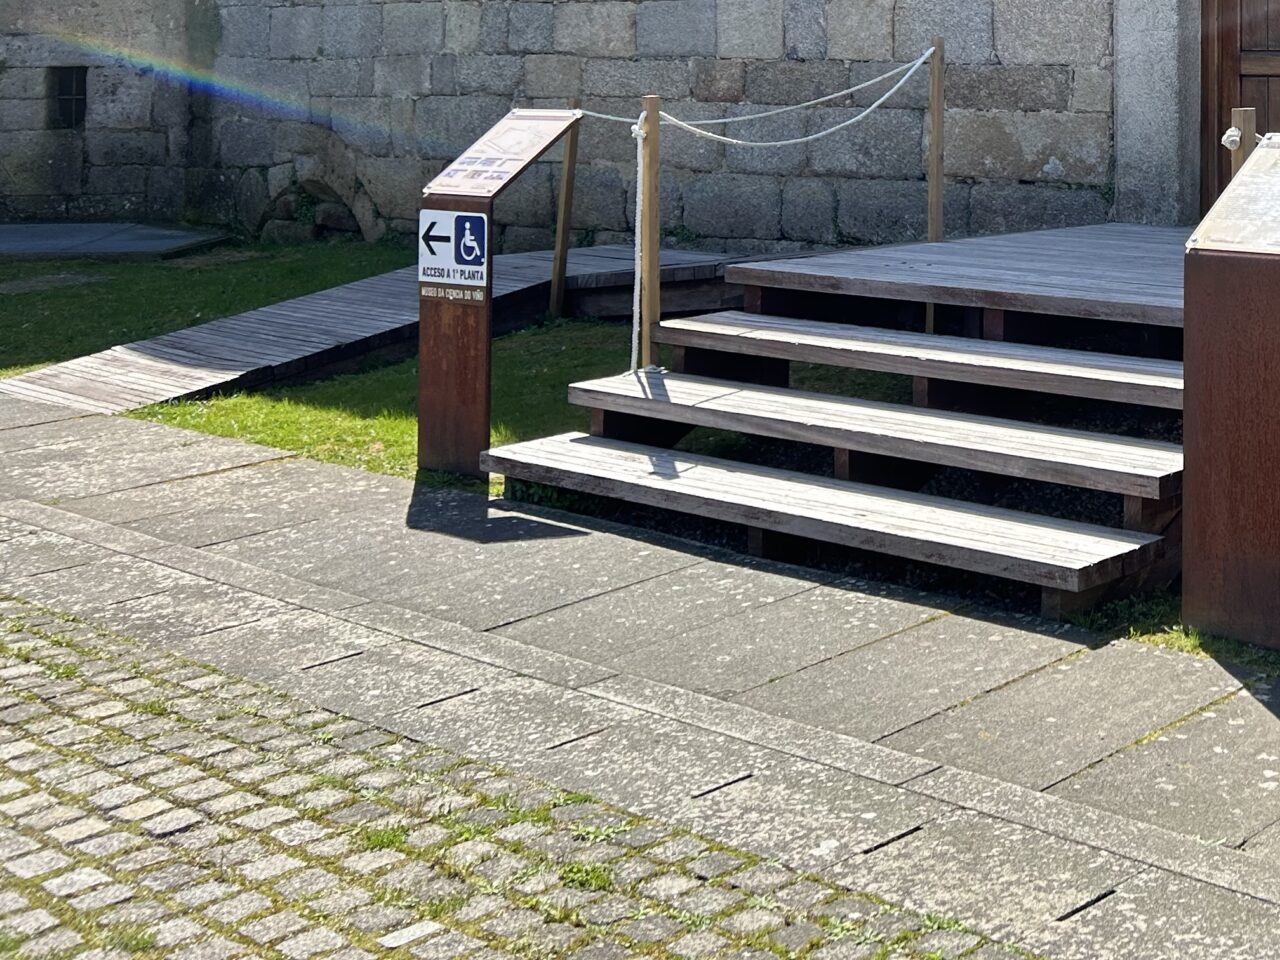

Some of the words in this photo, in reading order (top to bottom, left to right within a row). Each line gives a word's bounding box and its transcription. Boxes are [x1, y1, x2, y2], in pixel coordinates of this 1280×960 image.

[422, 266, 445, 278] ACCESO
[446, 268, 451, 279] A
[460, 269, 484, 281] PLANTA
